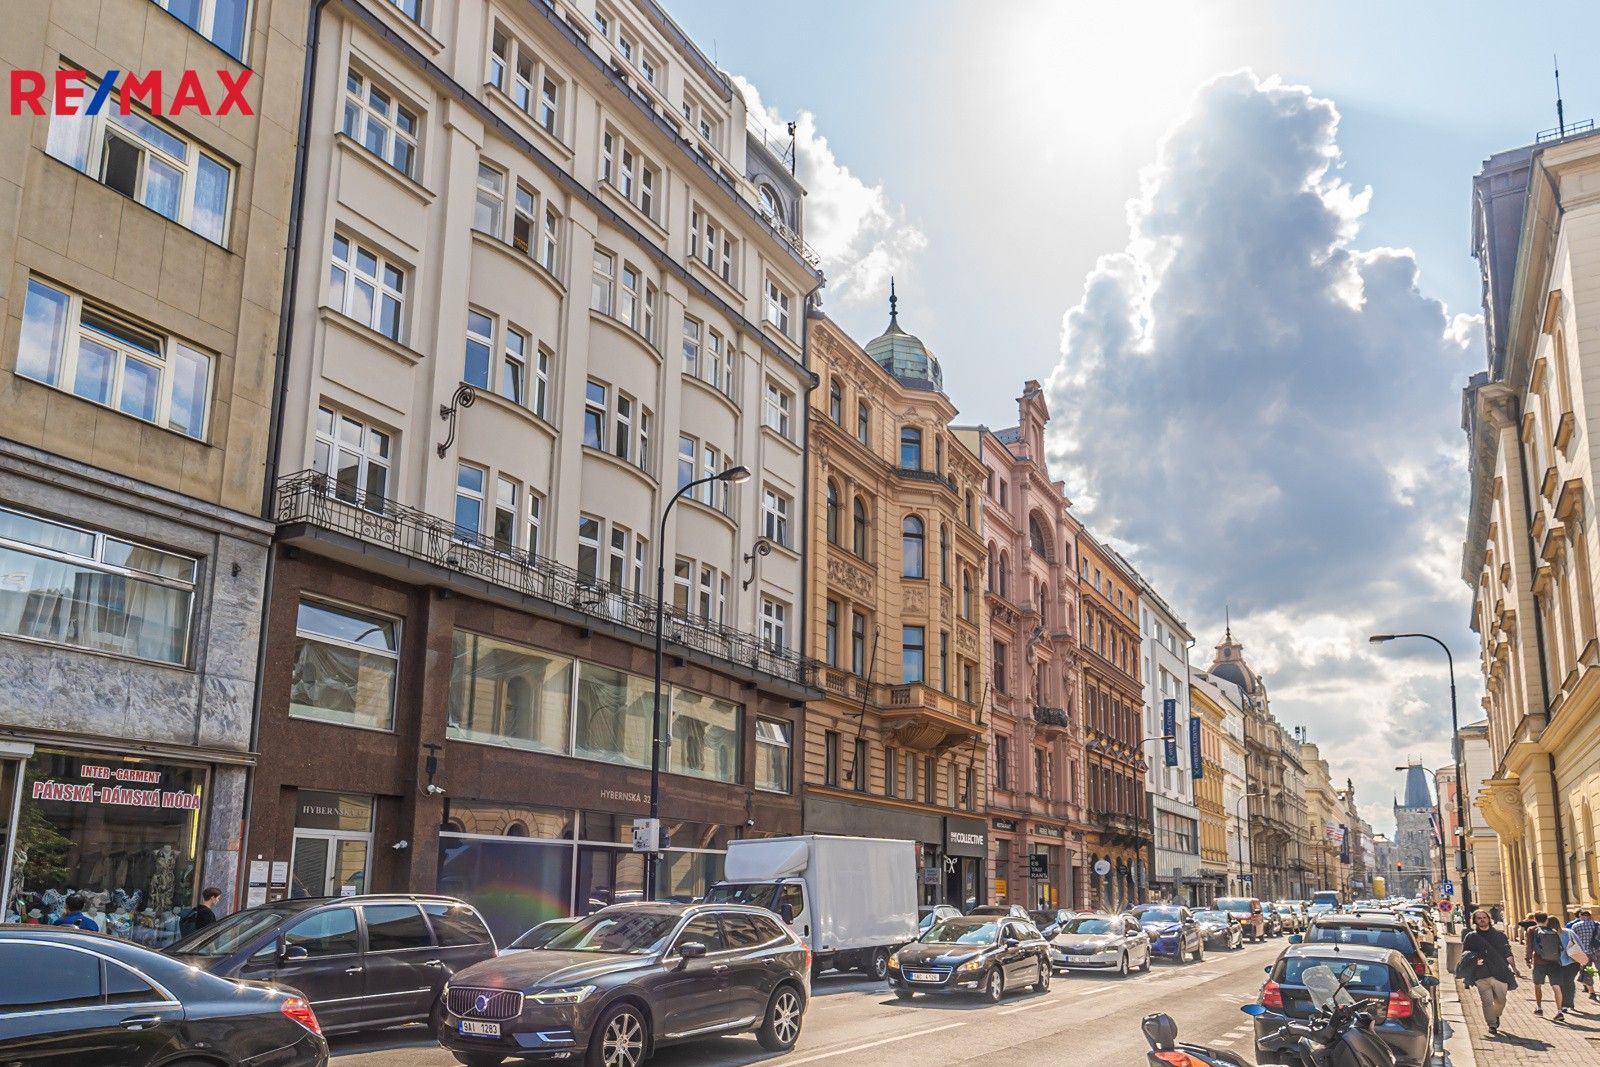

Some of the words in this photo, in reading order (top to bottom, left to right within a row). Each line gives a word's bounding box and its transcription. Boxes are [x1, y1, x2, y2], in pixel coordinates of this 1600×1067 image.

[162, 790, 201, 810] MÓDA
[600, 789, 641, 802] HYBERNSKÁ
[957, 833, 984, 845] COLLECTIVE
